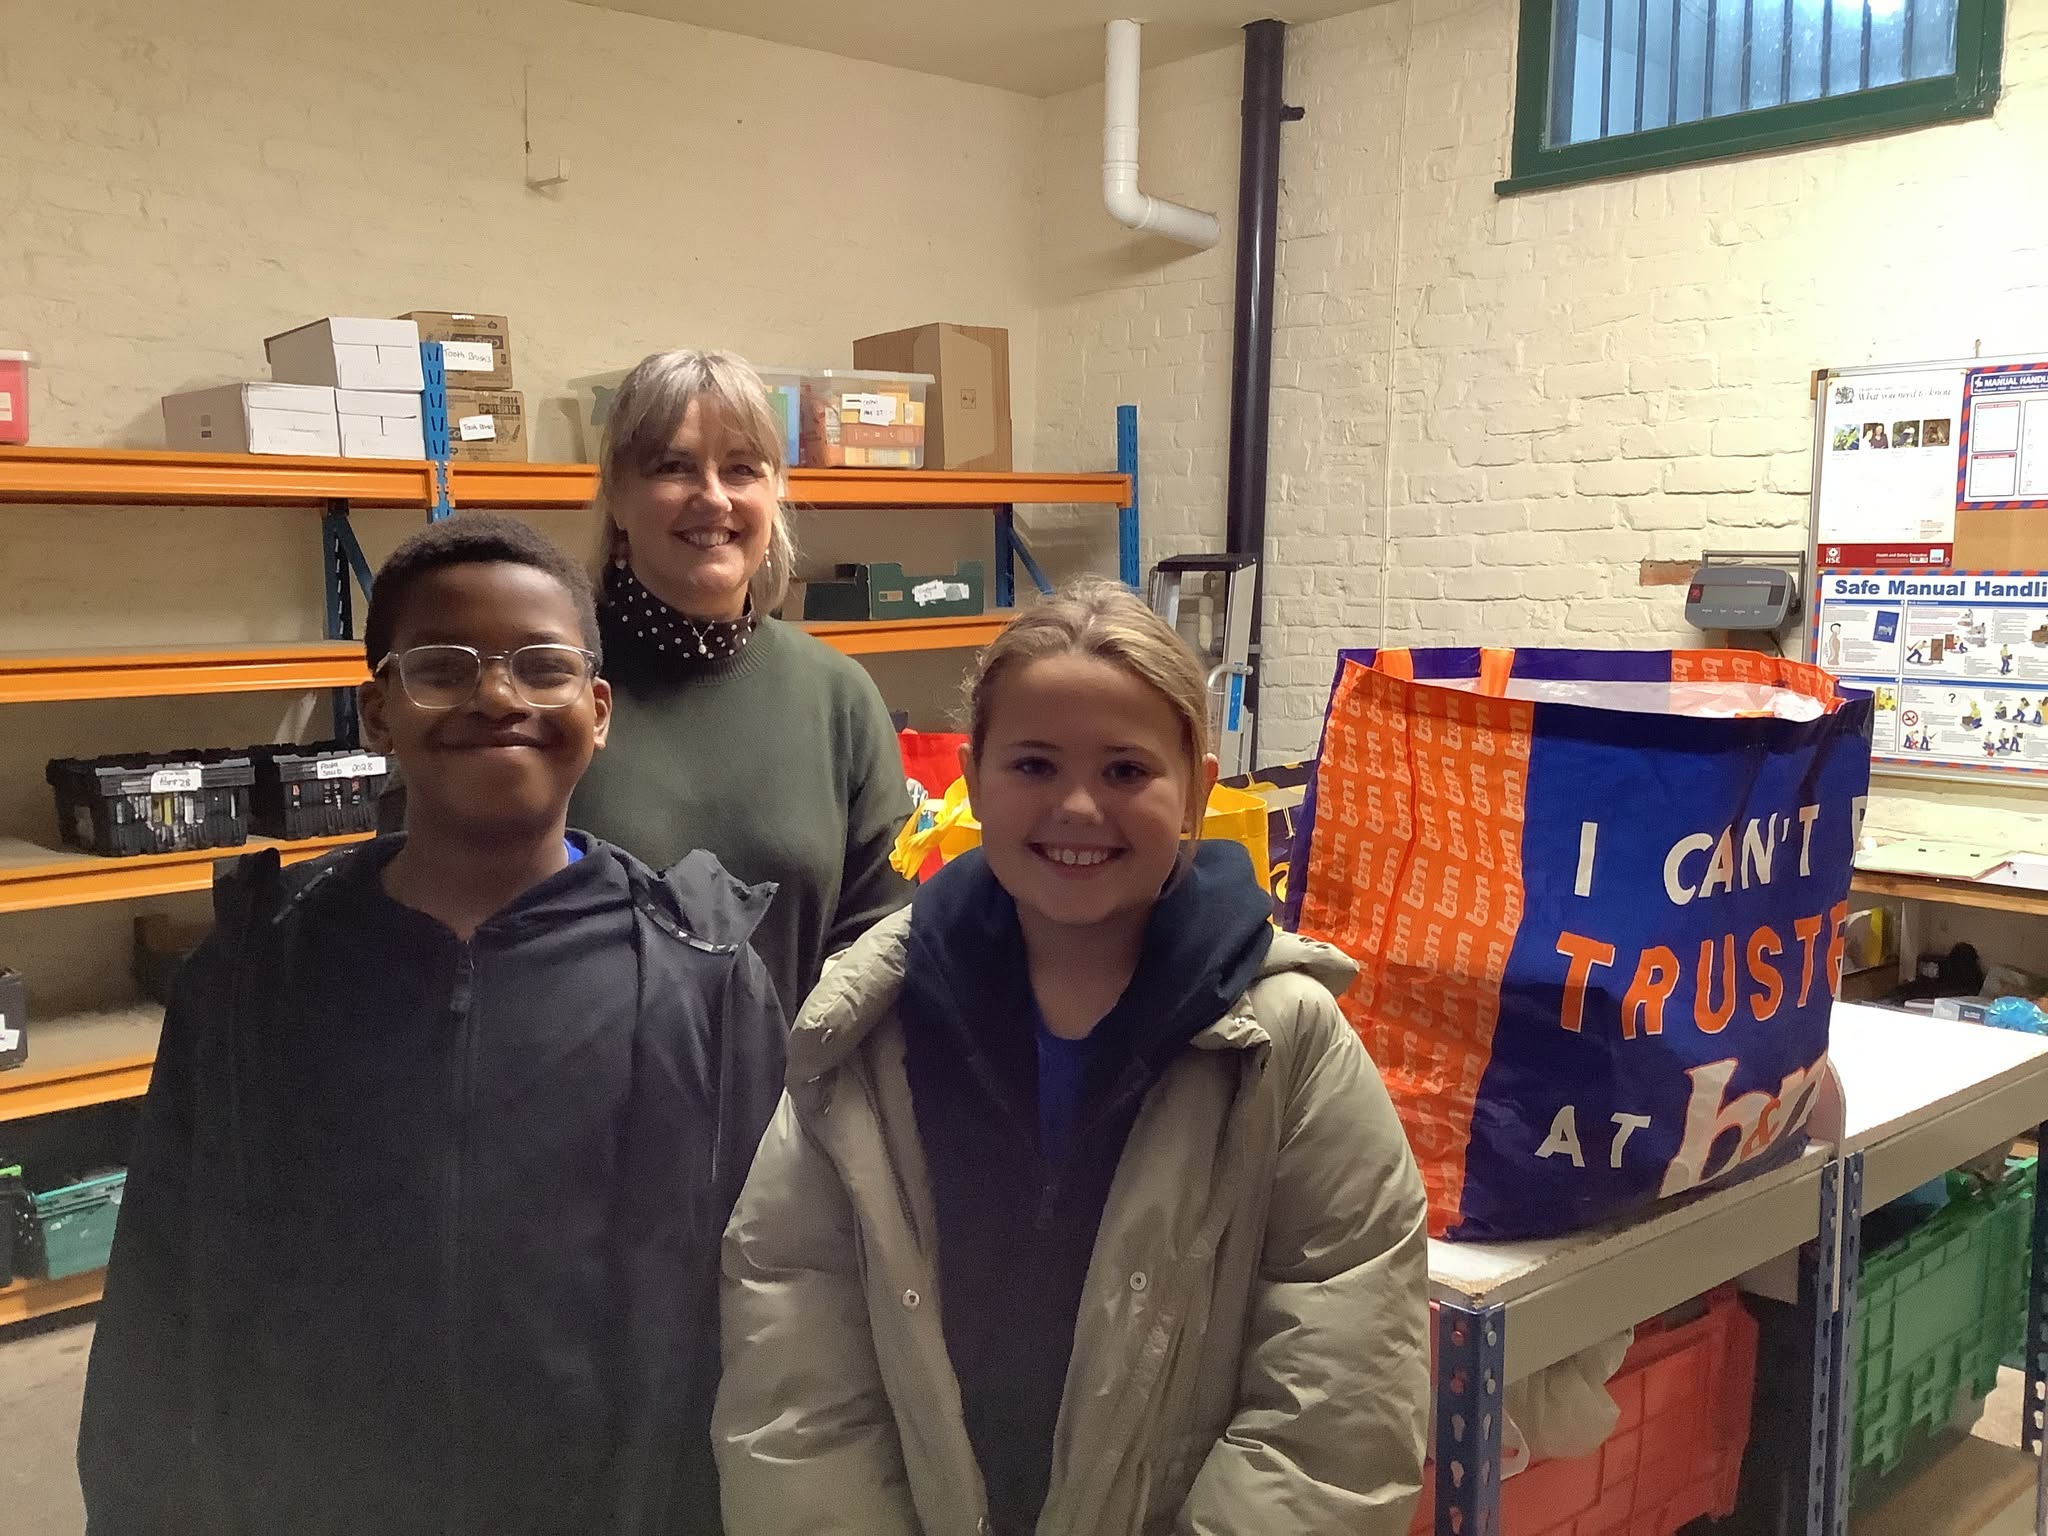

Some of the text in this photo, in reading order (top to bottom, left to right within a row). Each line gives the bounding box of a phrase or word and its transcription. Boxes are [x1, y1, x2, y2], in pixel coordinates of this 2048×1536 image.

[1984, 377, 2018, 387] MANUAL
[1825, 556, 1841, 564] HSE
[1835, 579, 2048, 597] Safe Manual Handli
[1574, 821, 1598, 897] I
[1663, 803, 1820, 906] CAN'T
[1534, 1104, 1652, 1169] AT
